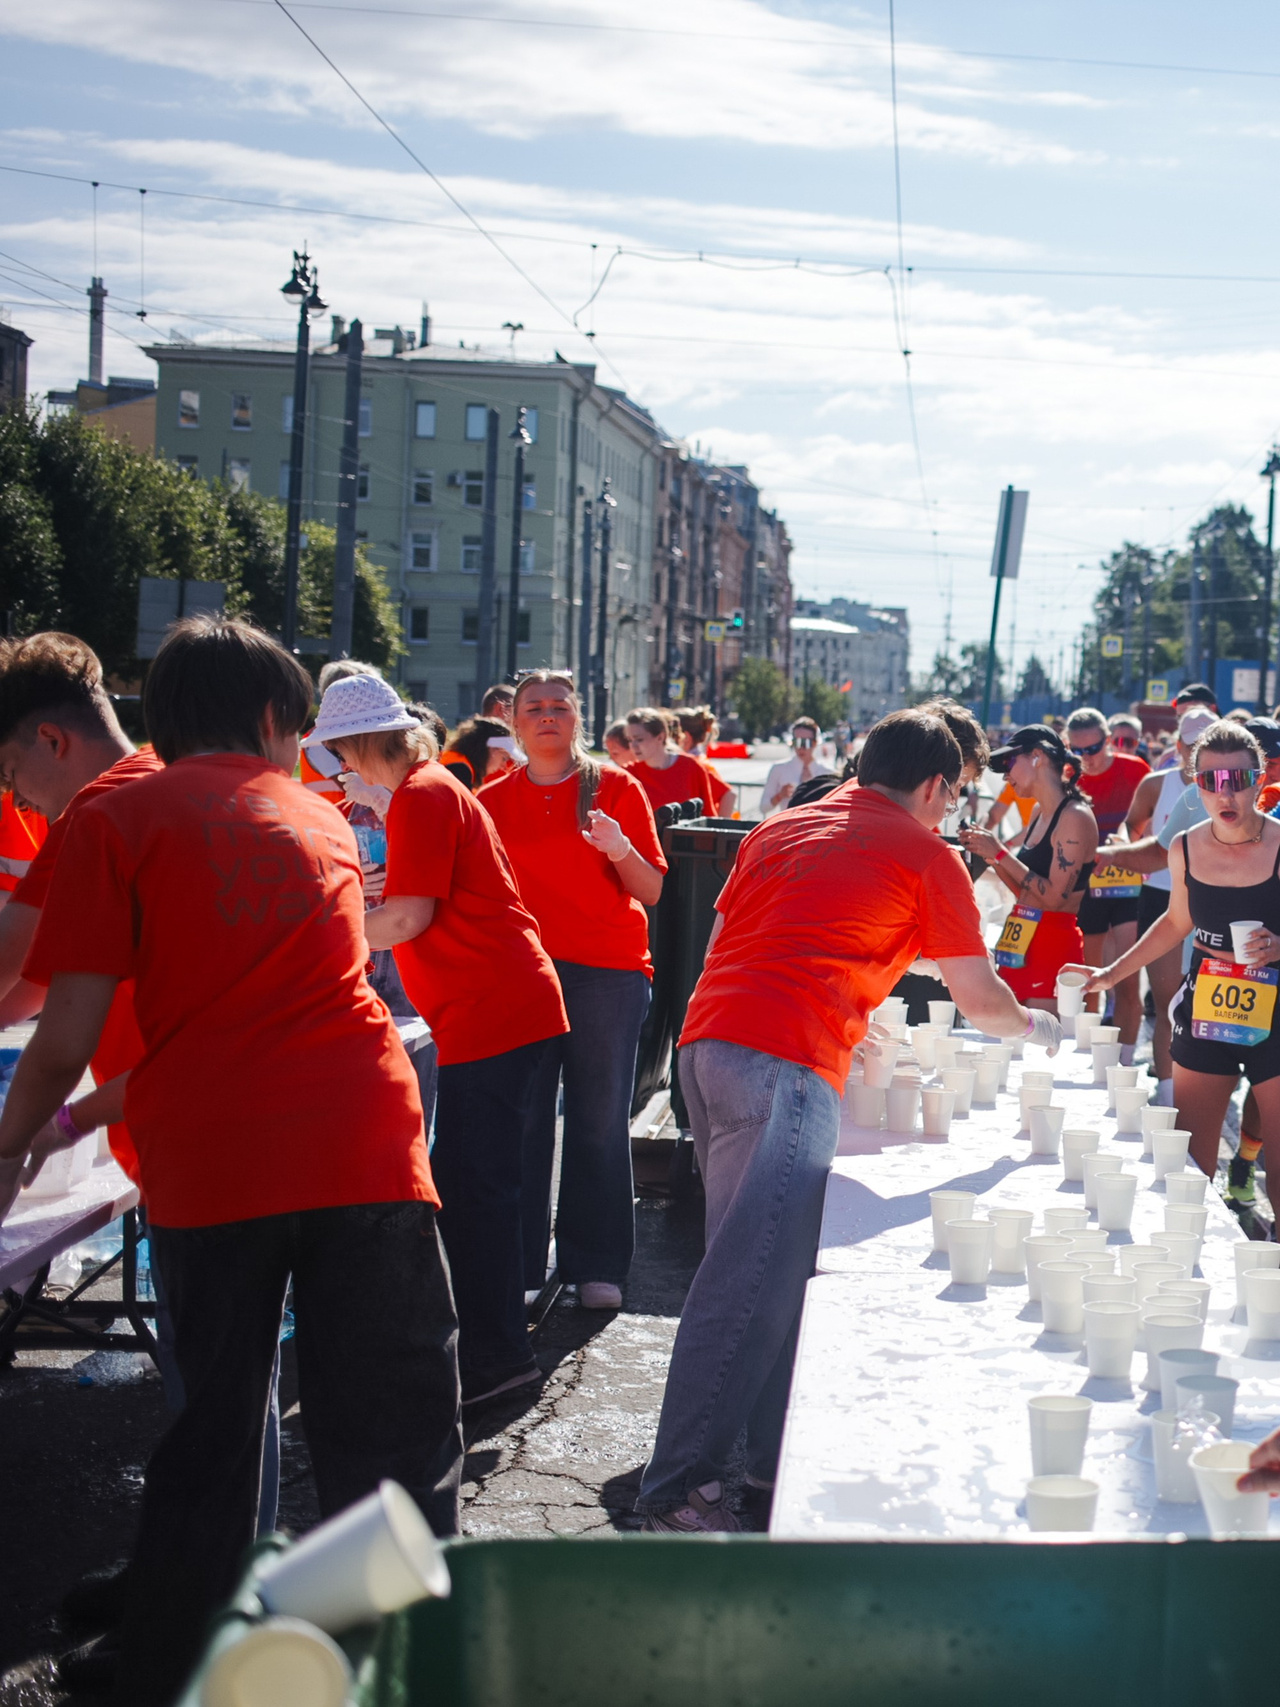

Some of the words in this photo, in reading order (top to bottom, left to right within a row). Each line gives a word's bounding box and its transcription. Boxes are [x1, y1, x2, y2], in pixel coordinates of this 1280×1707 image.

[1094, 888, 1102, 897] D
[1244, 968, 1257, 977] 21,1
[1211, 983, 1257, 1013] 603
[1214, 1009, 1249, 1021] ВАЛЕРИЯ
[1198, 1022, 1208, 1036] E
